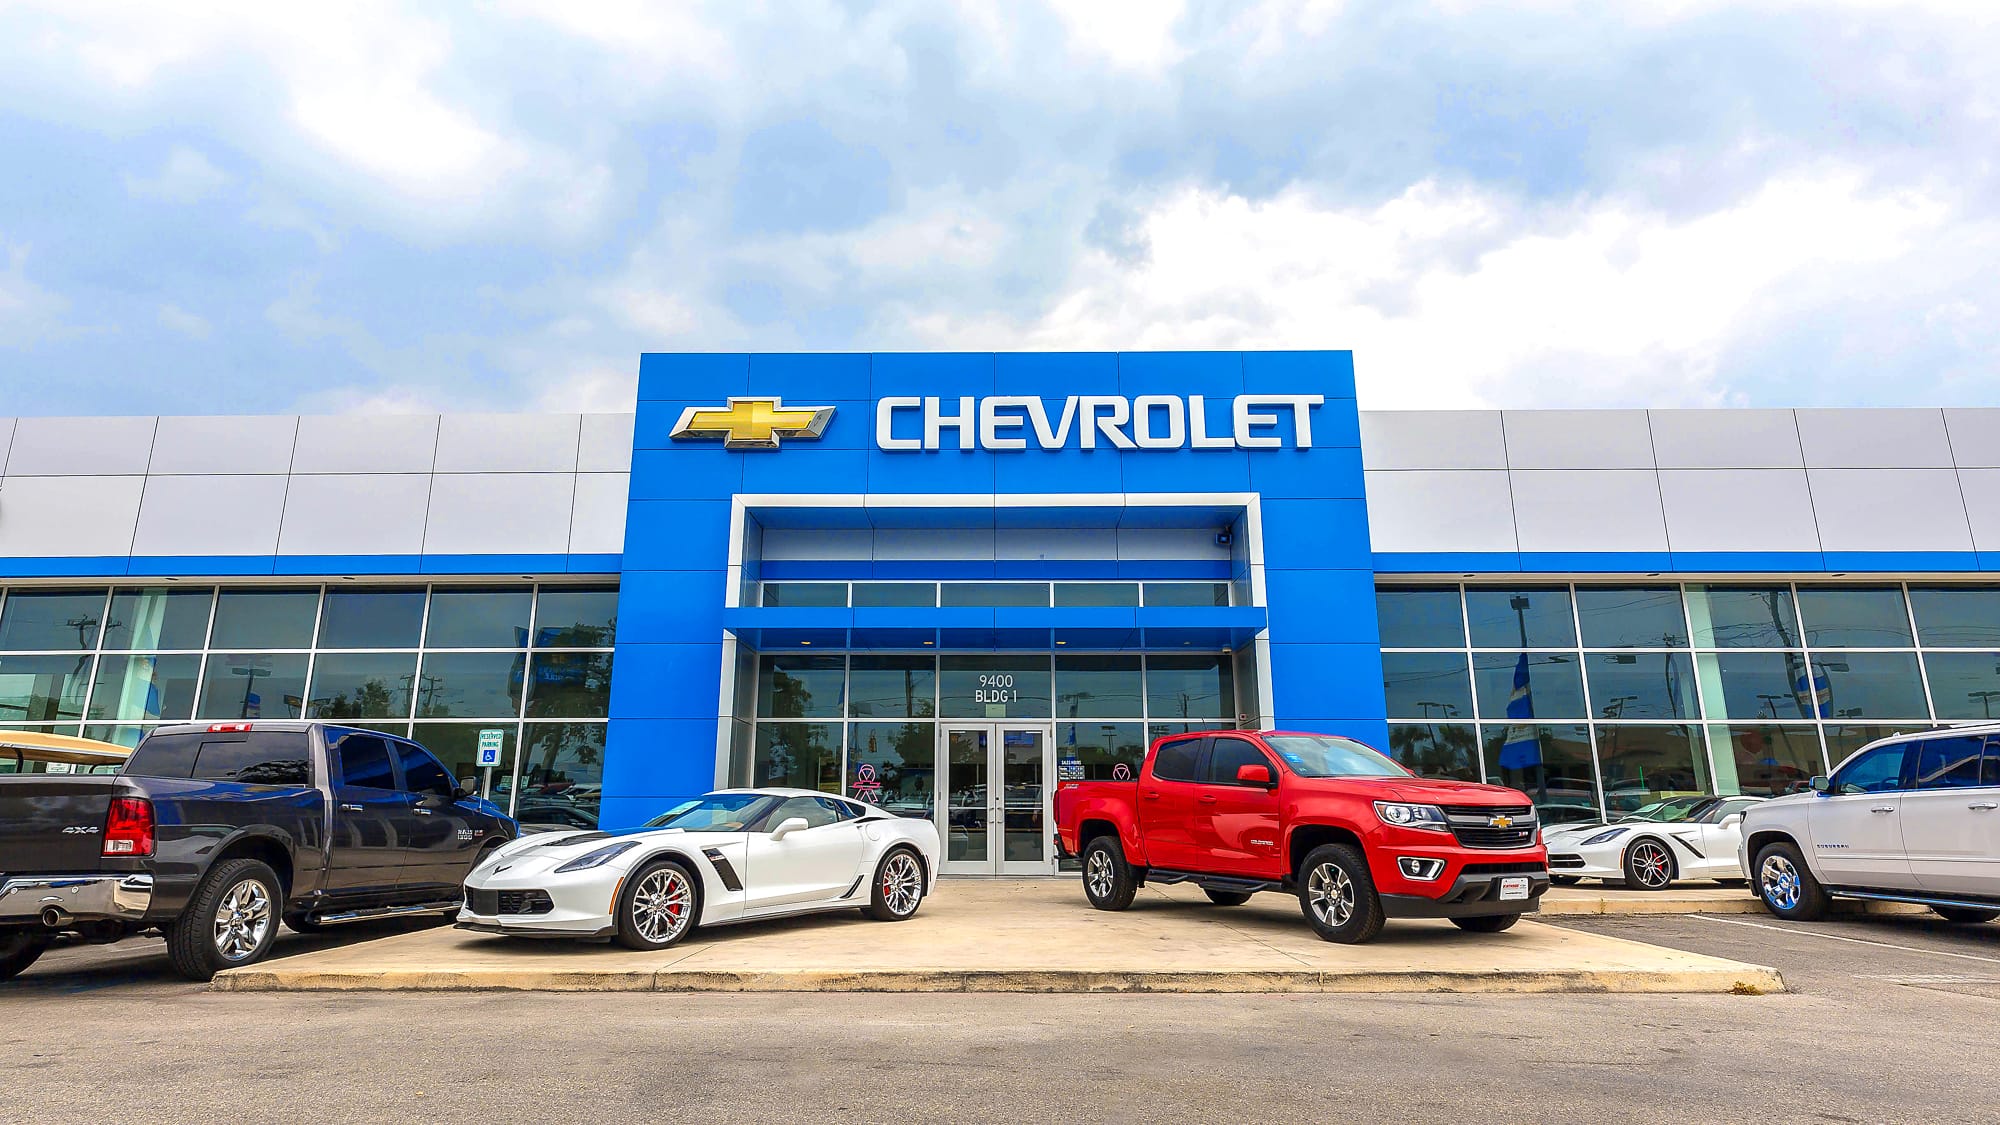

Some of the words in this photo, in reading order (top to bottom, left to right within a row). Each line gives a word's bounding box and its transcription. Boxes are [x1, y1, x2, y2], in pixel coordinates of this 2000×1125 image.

[876, 394, 1325, 451] CHEVROLET
[979, 674, 1013, 688] 9400
[975, 689, 1009, 703] BLDG
[1013, 689, 1017, 703] 1
